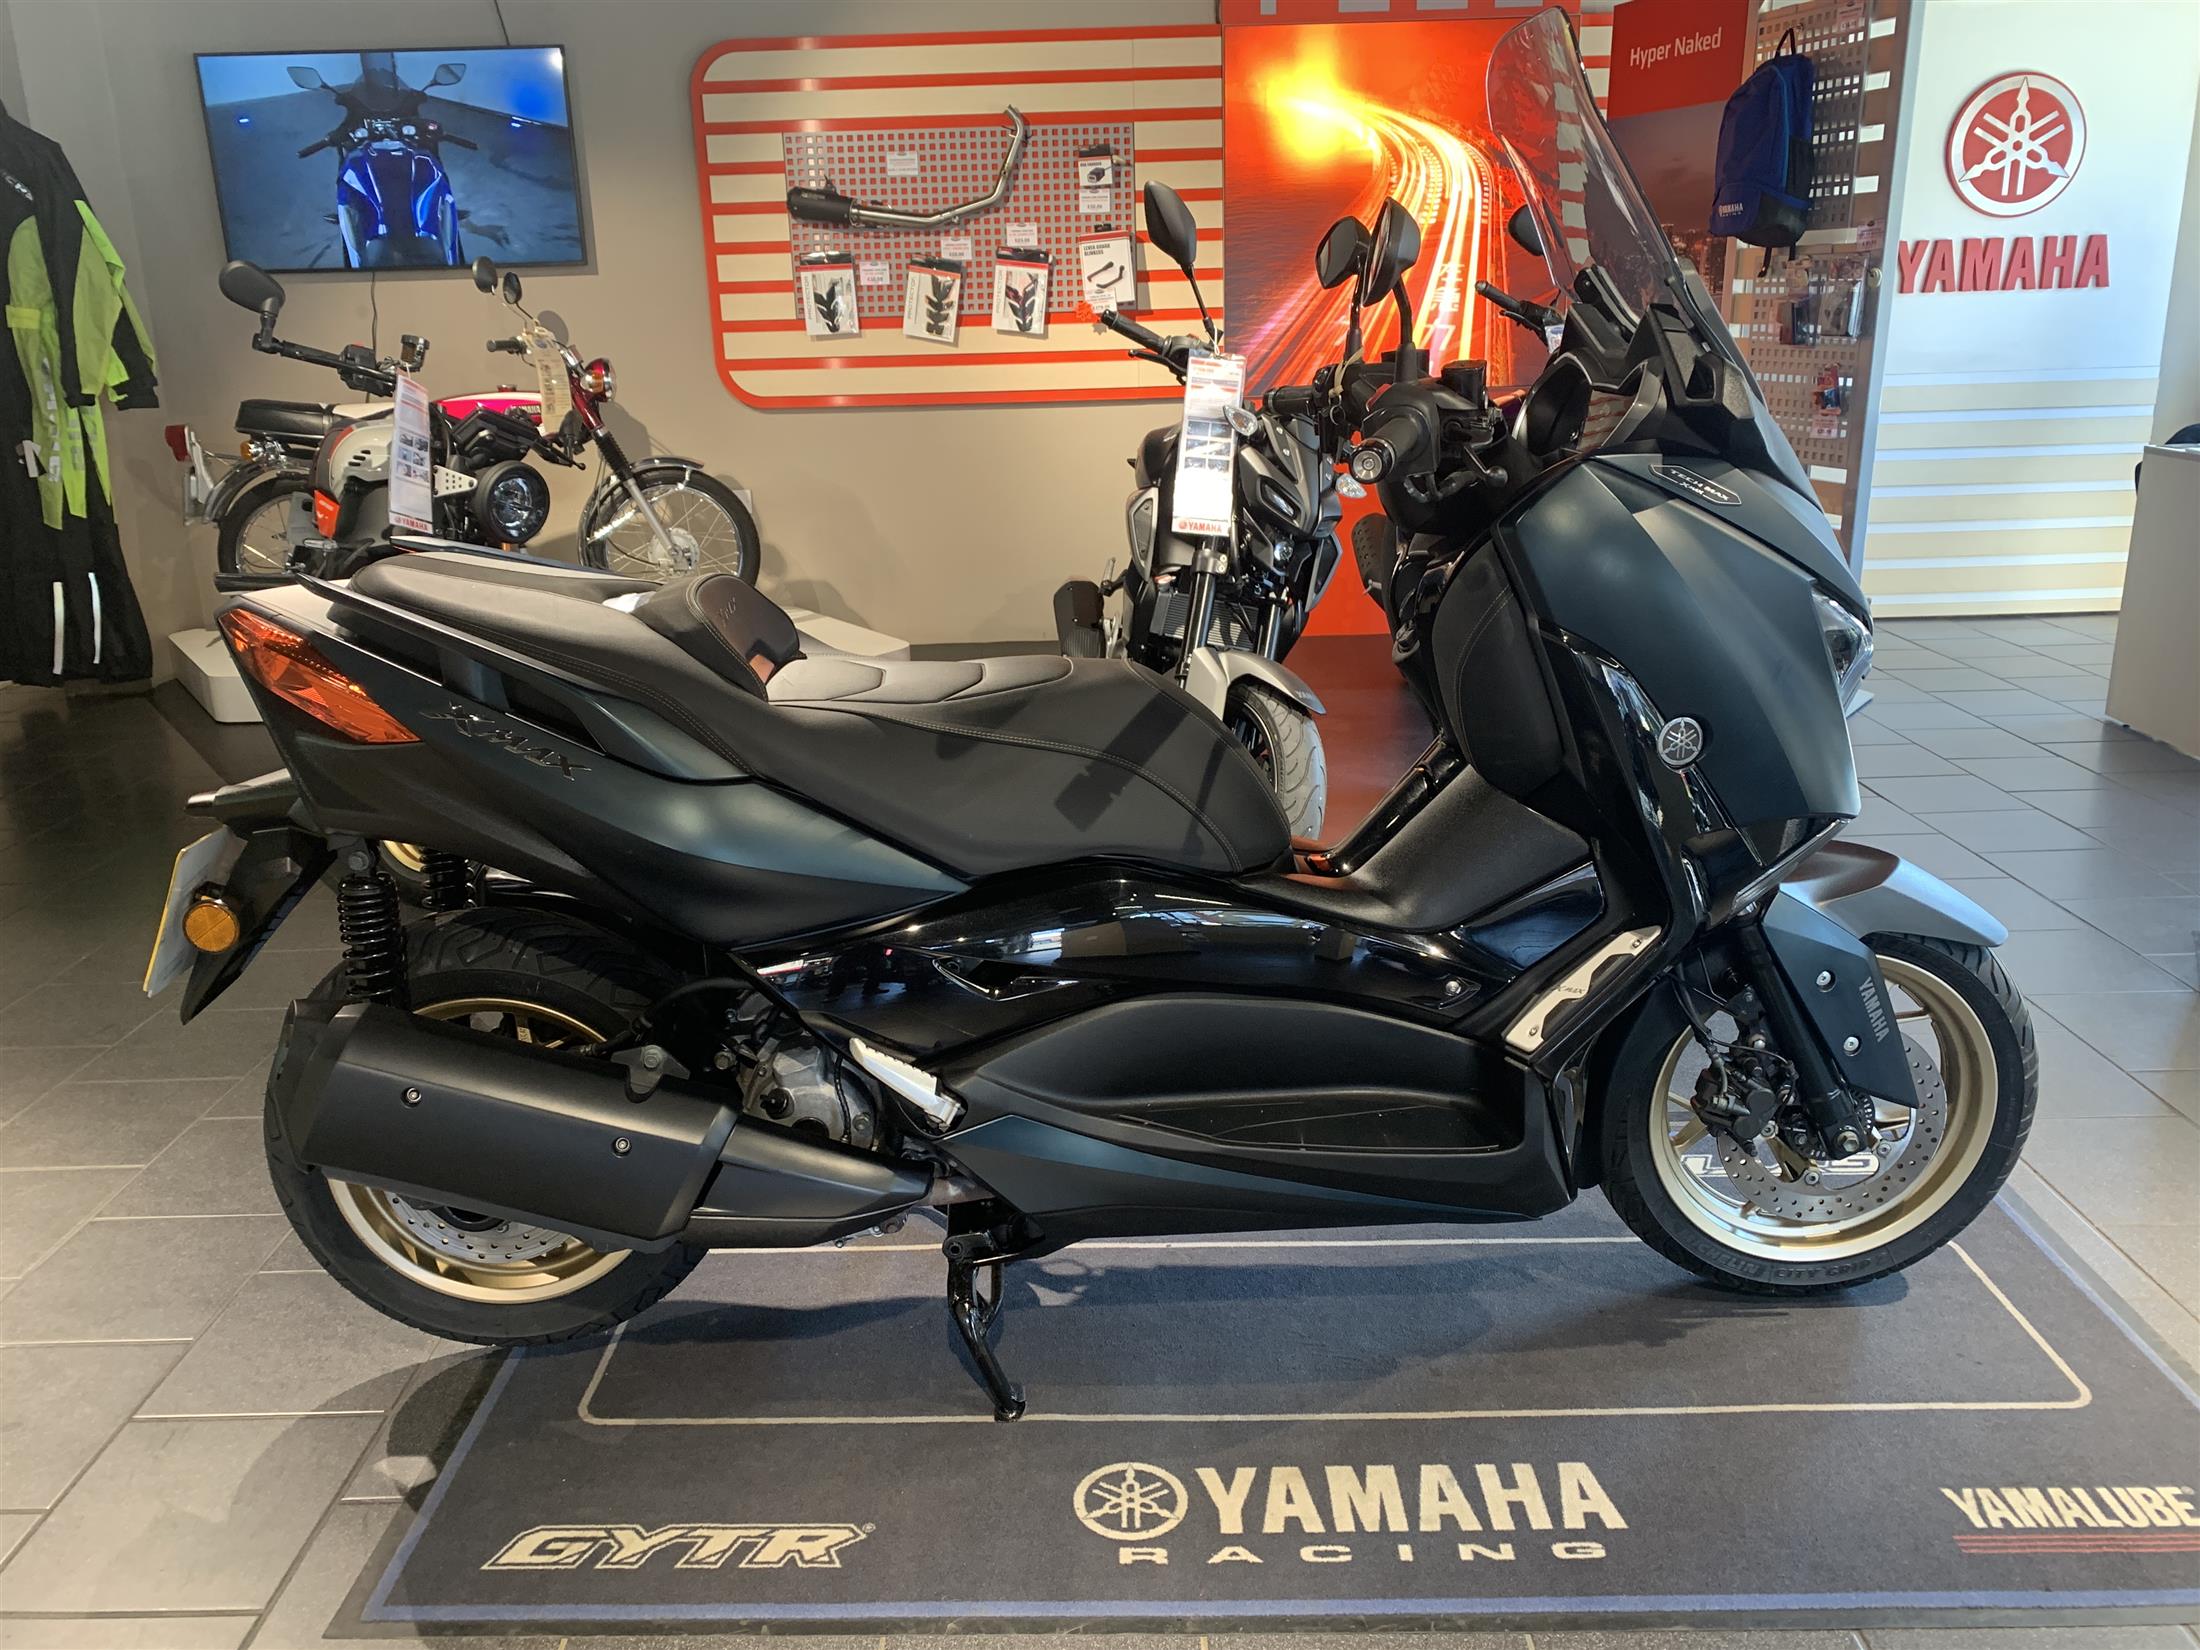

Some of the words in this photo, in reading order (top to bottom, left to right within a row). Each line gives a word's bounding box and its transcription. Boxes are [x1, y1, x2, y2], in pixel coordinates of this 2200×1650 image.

[1630, 47, 1671, 70] Hyper
[1675, 26, 1722, 57] Naked
[1897, 234, 2110, 294] YAMAHA
[401, 518, 429, 531] YAMAHA
[1188, 520, 1222, 533] YAMAHA
[1859, 976, 1890, 1043] YAMAHA
[1195, 1463, 1630, 1535] YAMAHA
[481, 1524, 867, 1570] GYTR
[1939, 1486, 2200, 1529] YAMALUBE
[1118, 1541, 1607, 1566] RACING
